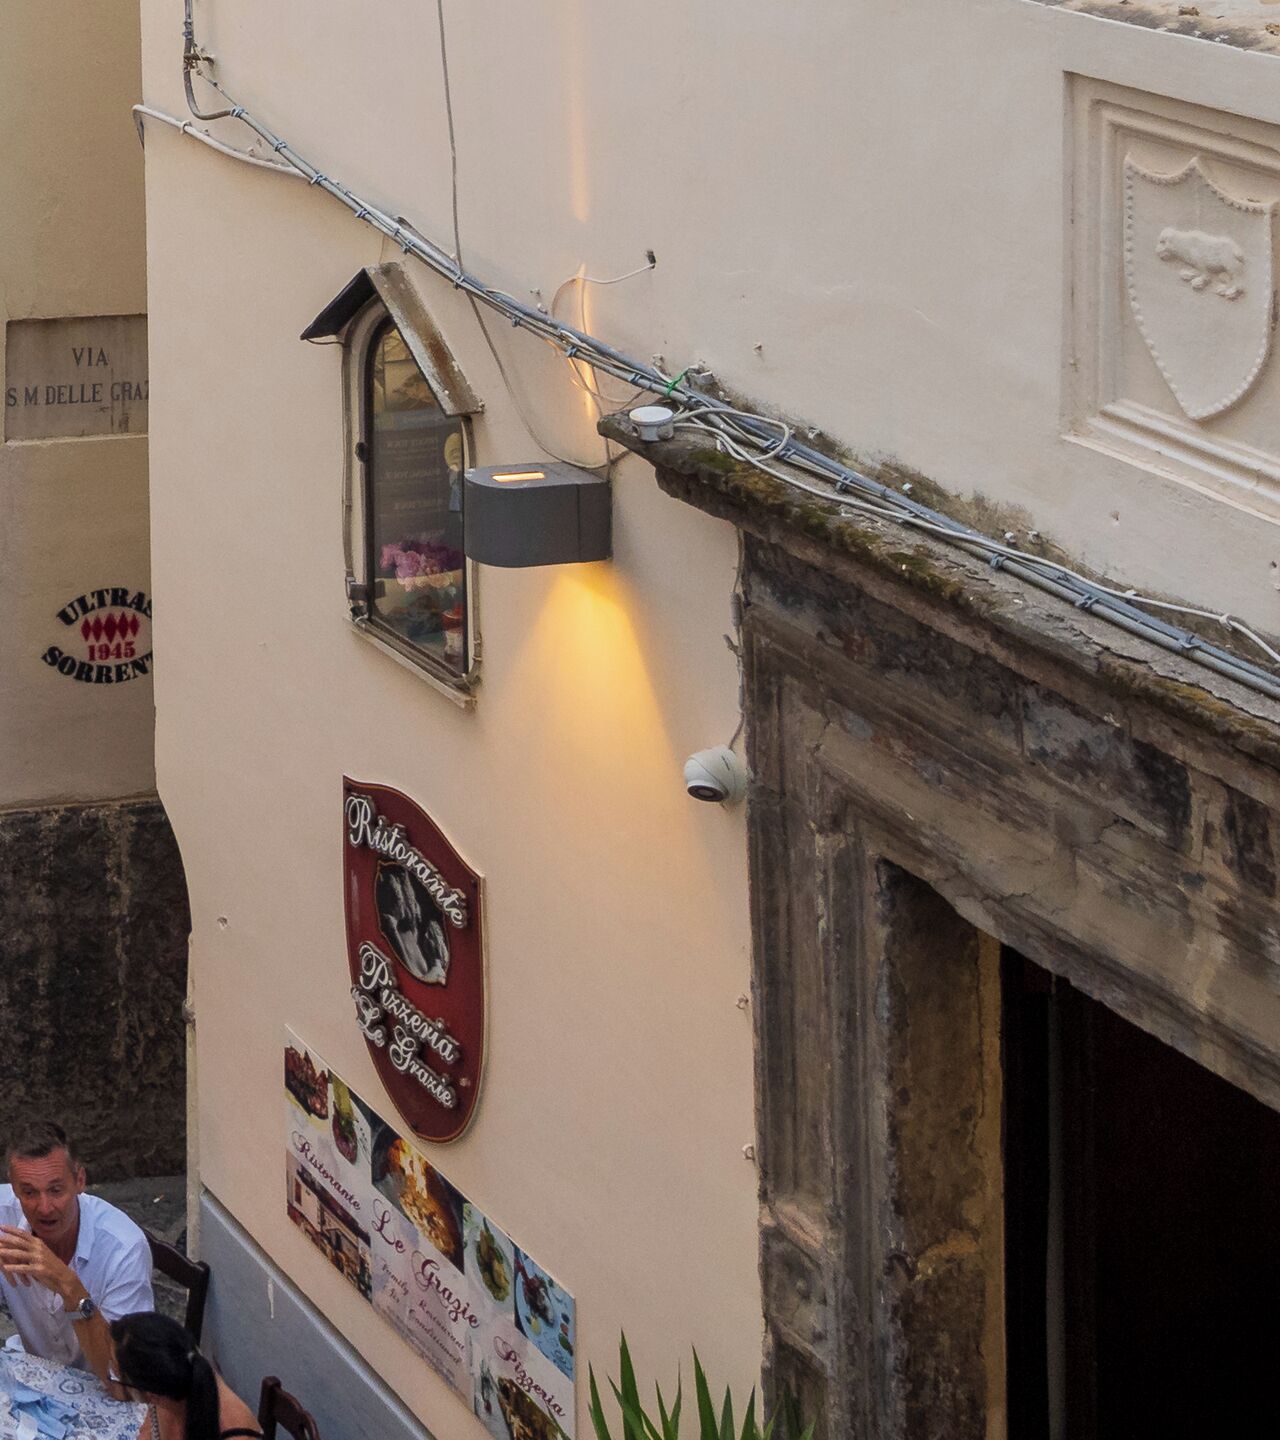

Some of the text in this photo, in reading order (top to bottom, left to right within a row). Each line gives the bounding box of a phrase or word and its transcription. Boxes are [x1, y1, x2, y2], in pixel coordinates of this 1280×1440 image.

[45, 382, 104, 405] DELLE
[71, 347, 110, 367] VIA
[88, 641, 137, 662] 1945
[345, 796, 464, 925] Ristorante
[359, 944, 459, 1061] Pizzeria
[390, 1025, 453, 1108] Grazie
[292, 1130, 361, 1211] Ristorante
[371, 1198, 406, 1254] Le
[411, 1250, 480, 1329] Grazie
[493, 1335, 566, 1417] Pizzeria
